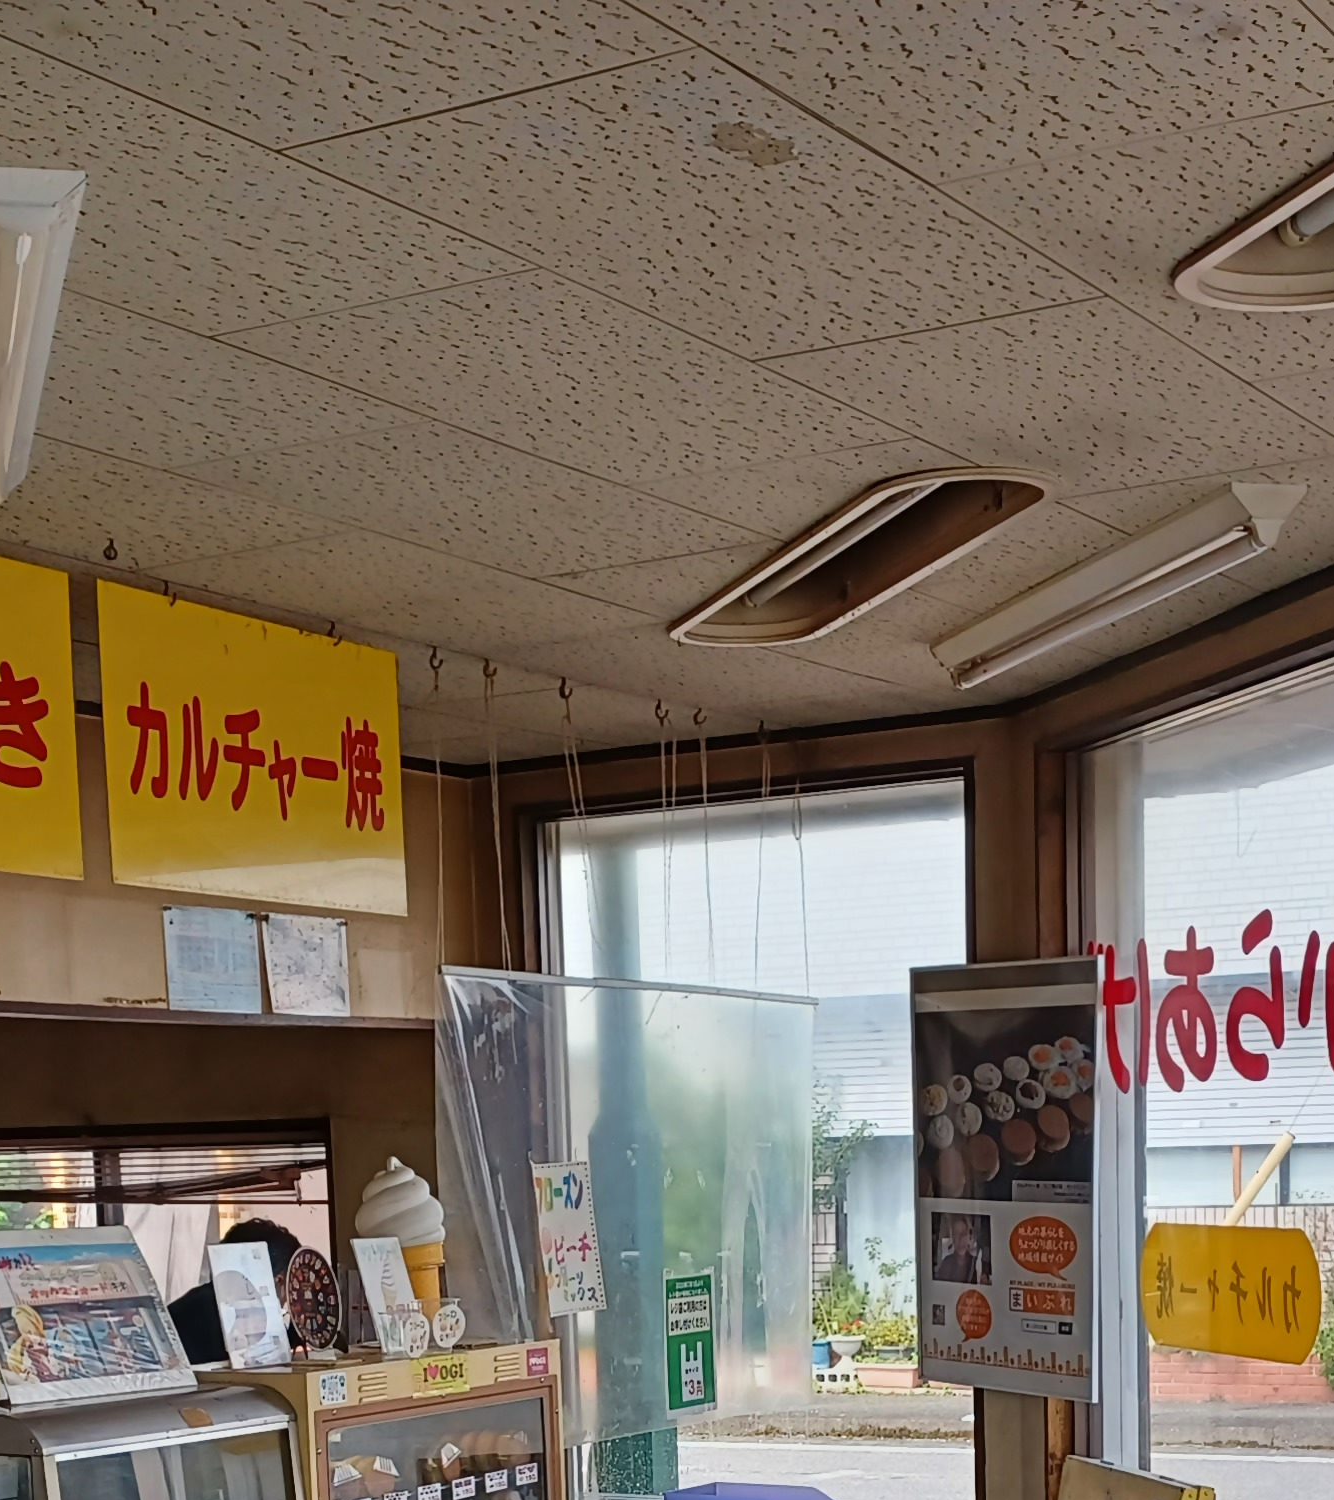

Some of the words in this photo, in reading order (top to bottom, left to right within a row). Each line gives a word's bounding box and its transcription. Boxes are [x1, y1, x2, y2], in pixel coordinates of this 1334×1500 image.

[125, 679, 386, 833] カルチャー焼
[535, 1169, 584, 1215] フローズン
[554, 1231, 592, 1265] ピーチ
[439, 1363, 465, 1380] OGI
